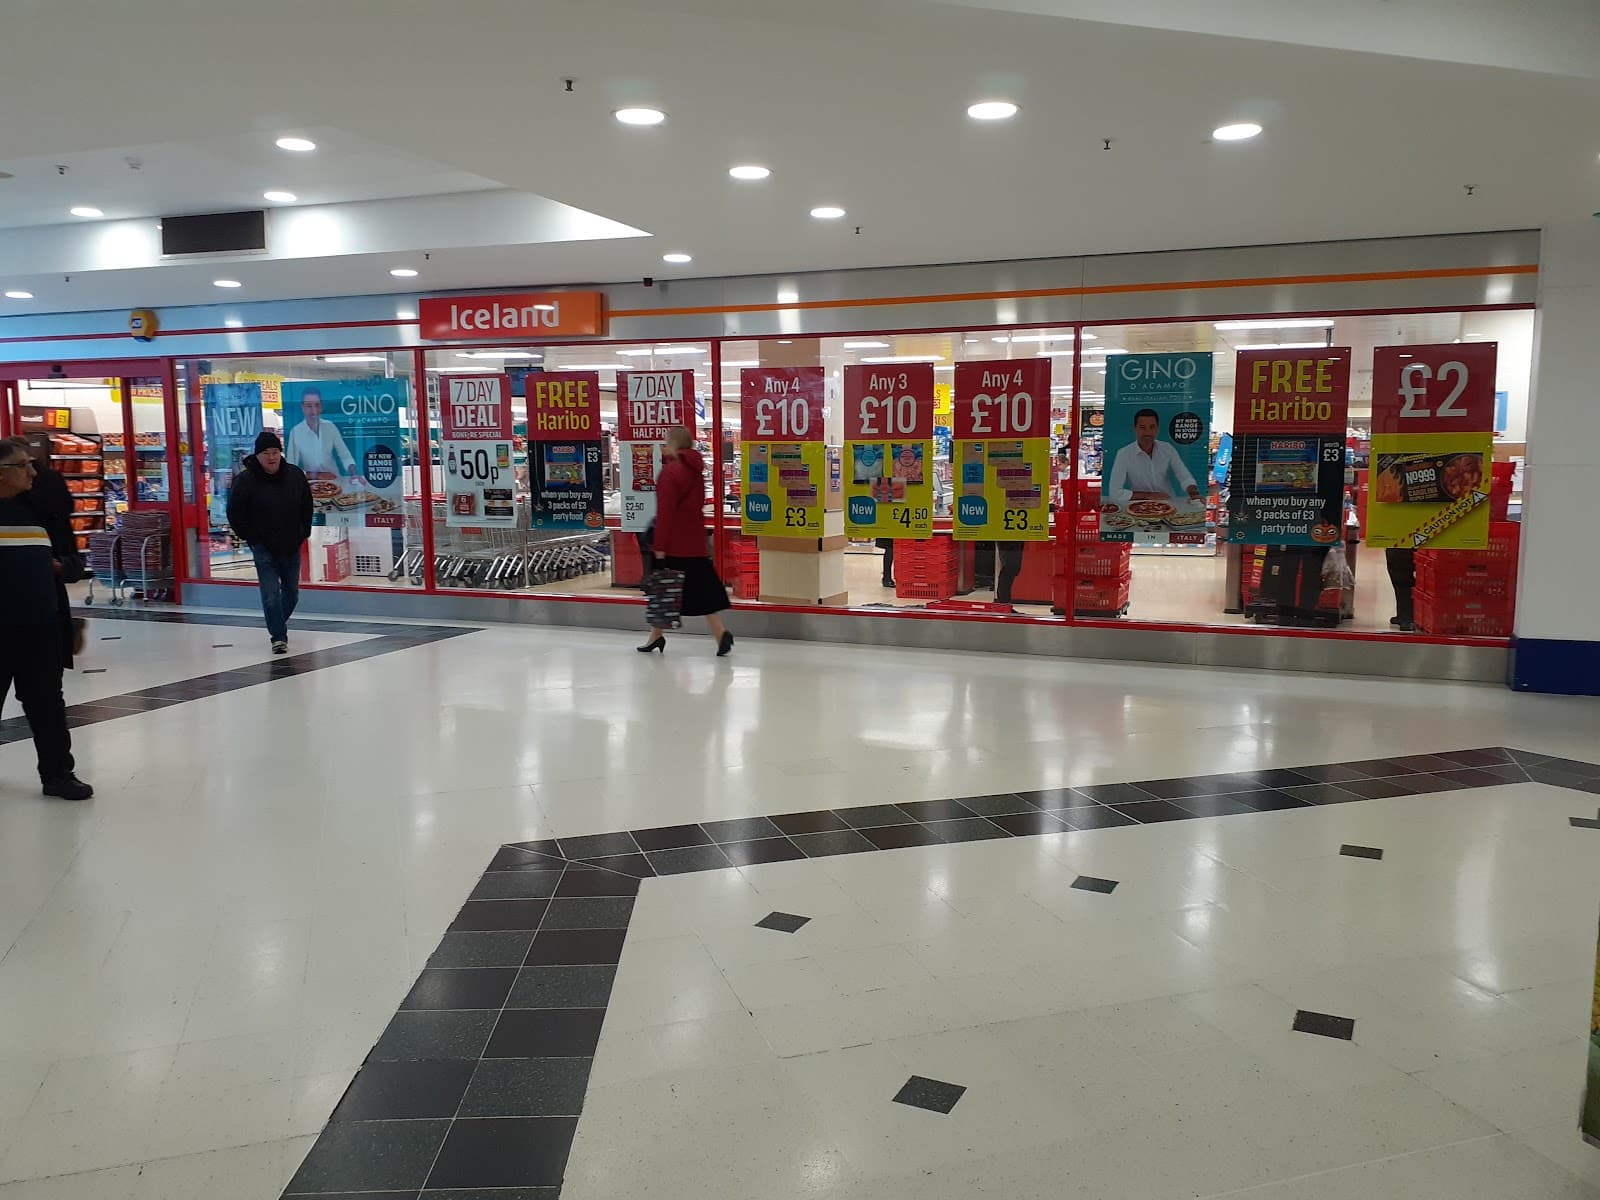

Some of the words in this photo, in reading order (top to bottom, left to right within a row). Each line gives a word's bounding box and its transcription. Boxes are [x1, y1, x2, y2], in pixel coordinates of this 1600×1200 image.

[451, 301, 560, 330] Iceland
[1121, 357, 1196, 380] GINO
[1252, 359, 1334, 394] FREE
[633, 377, 643, 399] 7
[647, 375, 677, 398] DAY
[765, 377, 789, 397] Any
[791, 377, 800, 393] 4
[870, 374, 895, 394] Any
[899, 373, 907, 389] 3
[981, 371, 1010, 391] Any
[1013, 369, 1023, 386] 4
[1398, 361, 1469, 418] £2
[455, 382, 463, 402] 7
[467, 381, 494, 402] DAY
[536, 381, 590, 409] FREE
[341, 394, 395, 415] GINO
[633, 401, 680, 425] DEAL
[860, 395, 917, 434] £10
[970, 392, 1032, 433] £10
[1251, 396, 1332, 421] Haribo
[212, 407, 256, 436] NEW
[455, 405, 497, 428] DEAL
[537, 411, 590, 431] Haribo
[756, 399, 809, 436] £10
[632, 427, 653, 439] HALF
[587, 452, 598, 462] £3
[1324, 449, 1339, 461] £3
[460, 449, 499, 485] 50p
[582, 491, 592, 500] any
[1247, 495, 1271, 506] when
[1272, 497, 1289, 509] you
[1291, 496, 1308, 509] buy
[1309, 498, 1326, 509] any
[749, 500, 769, 513] New
[785, 507, 806, 527] £3
[852, 504, 873, 515] New
[962, 504, 984, 516] New
[1256, 509, 1262, 519] 3
[1263, 509, 1290, 521] packs
[1292, 509, 1301, 519] of
[1303, 510, 1314, 520] £3
[1424, 511, 1456, 534] CAUTION
[1456, 499, 1472, 513] HOT
[1003, 510, 1027, 530] £3
[1262, 523, 1285, 535] party
[1287, 522, 1308, 534] food
